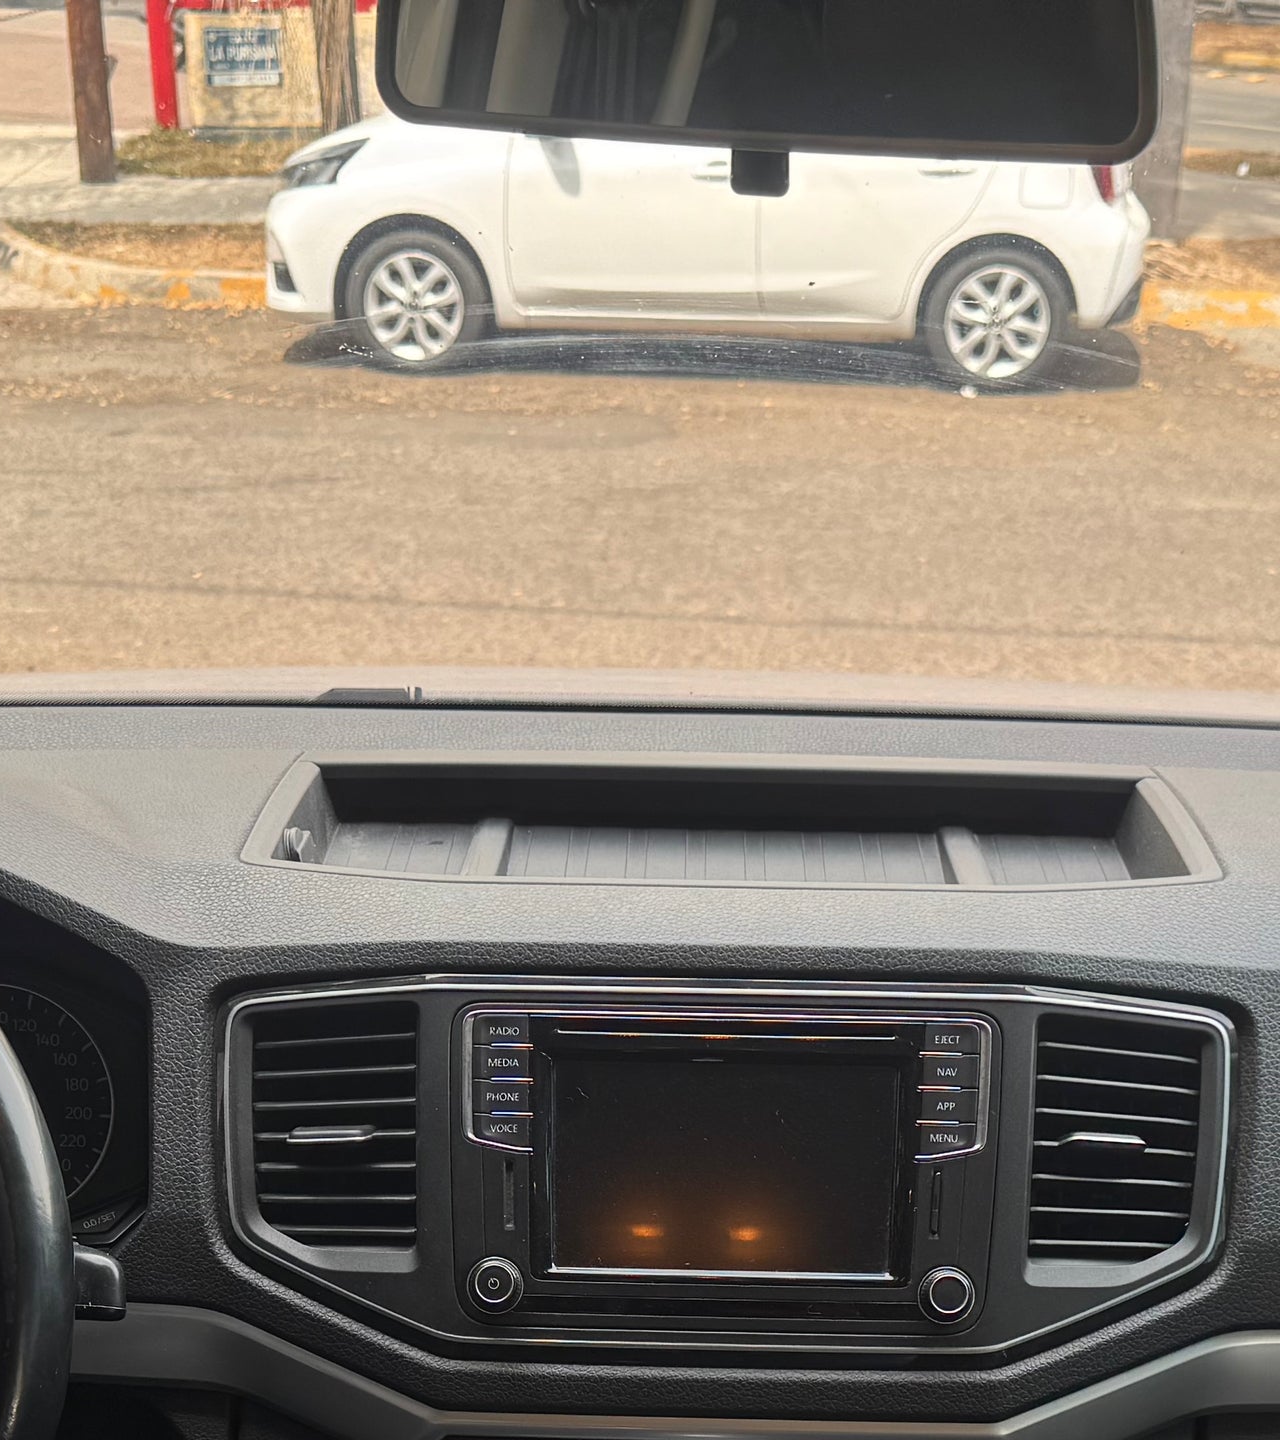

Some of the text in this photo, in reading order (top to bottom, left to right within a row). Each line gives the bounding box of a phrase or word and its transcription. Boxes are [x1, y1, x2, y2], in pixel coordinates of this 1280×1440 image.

[11, 1019, 37, 1032] 120
[489, 1026, 520, 1036] RADIO
[35, 1032, 60, 1046] 140
[934, 1034, 960, 1044] EJECT
[53, 1052, 77, 1066] 160
[487, 1058, 520, 1067] MEDIA
[936, 1067, 958, 1077] NAV
[64, 1077, 89, 1091] 180
[486, 1092, 520, 1102] PHONE
[936, 1102, 956, 1111] APP
[64, 1106, 93, 1120] 200
[489, 1123, 518, 1133] VOICE
[59, 1134, 86, 1148] 220
[929, 1133, 959, 1143] MENU
